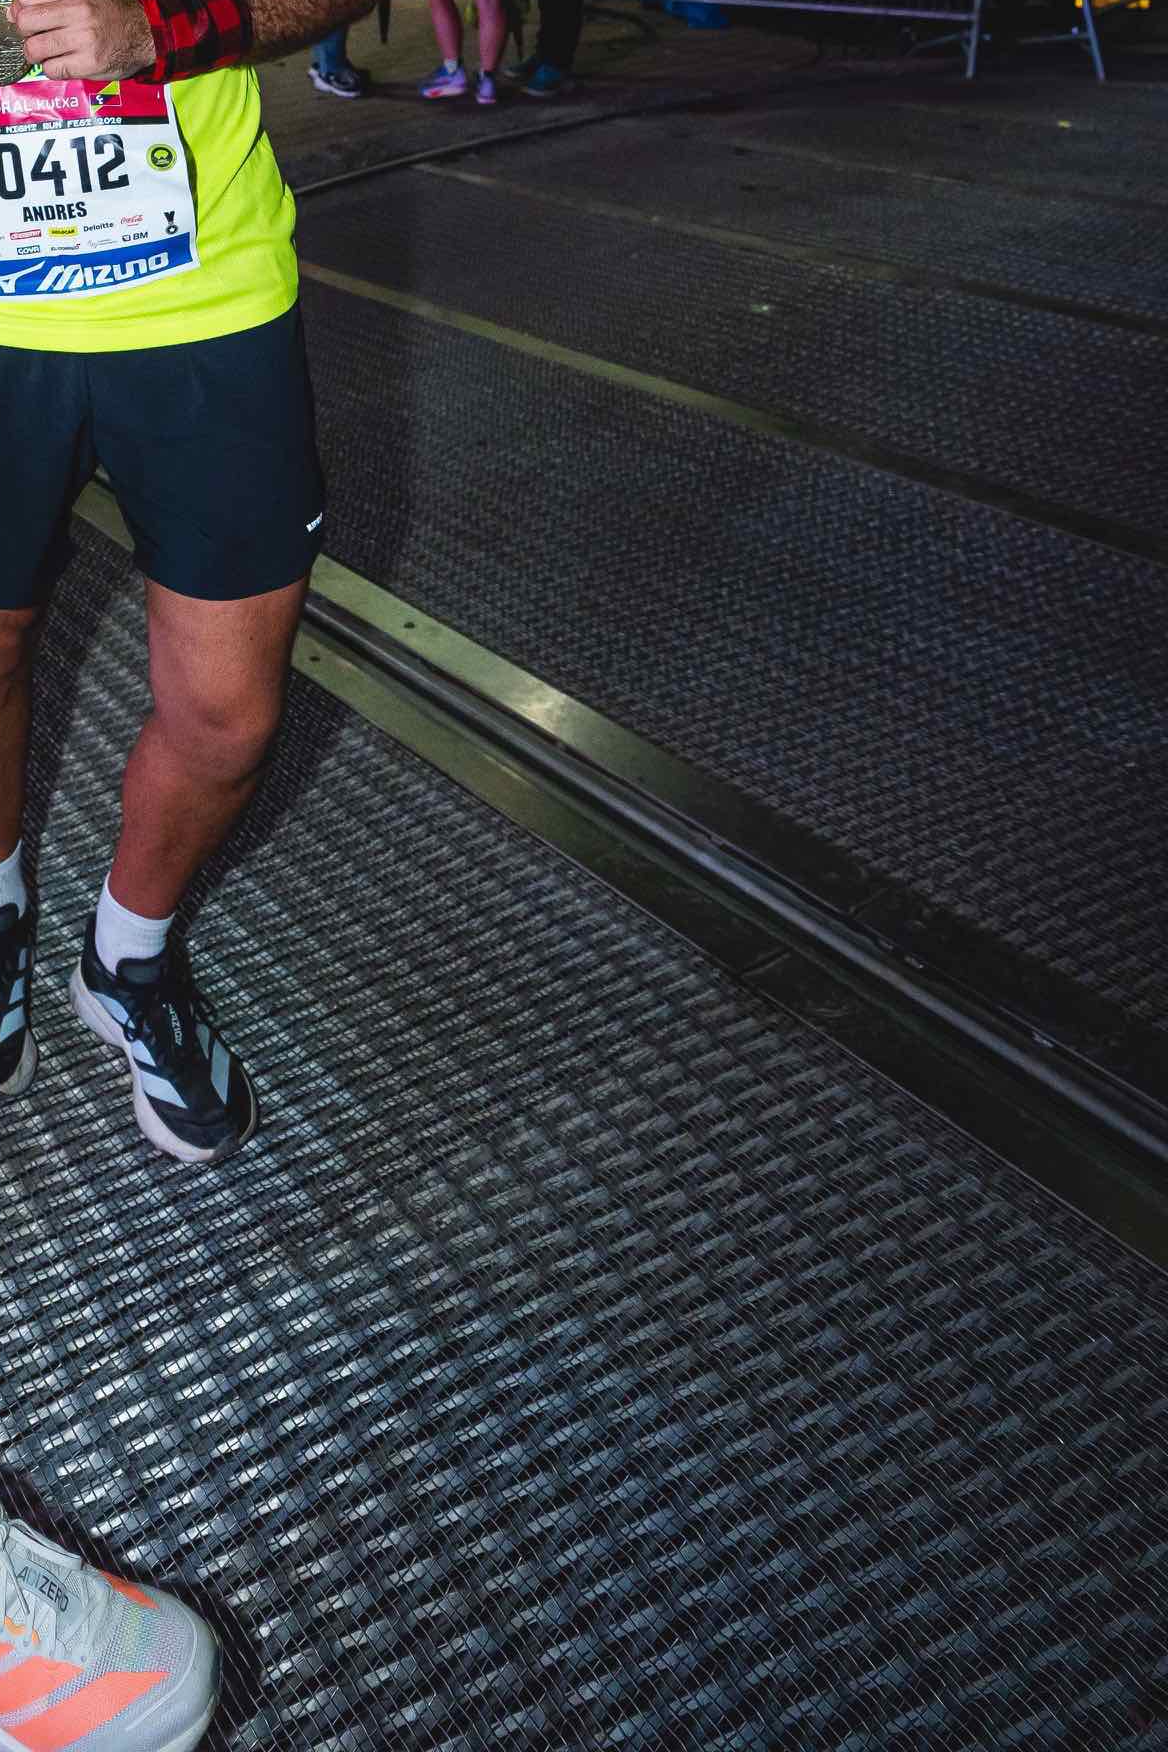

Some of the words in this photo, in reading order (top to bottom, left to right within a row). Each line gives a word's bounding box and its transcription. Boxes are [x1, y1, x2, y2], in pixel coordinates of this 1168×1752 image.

[36, 96, 79, 111] kutxa
[22, 201, 88, 223] ANDRES
[83, 222, 114, 232] Deloitte
[132, 232, 149, 240] BM
[36, 252, 169, 292] MIZUNO
[16, 1566, 69, 1612] ADIZERO
